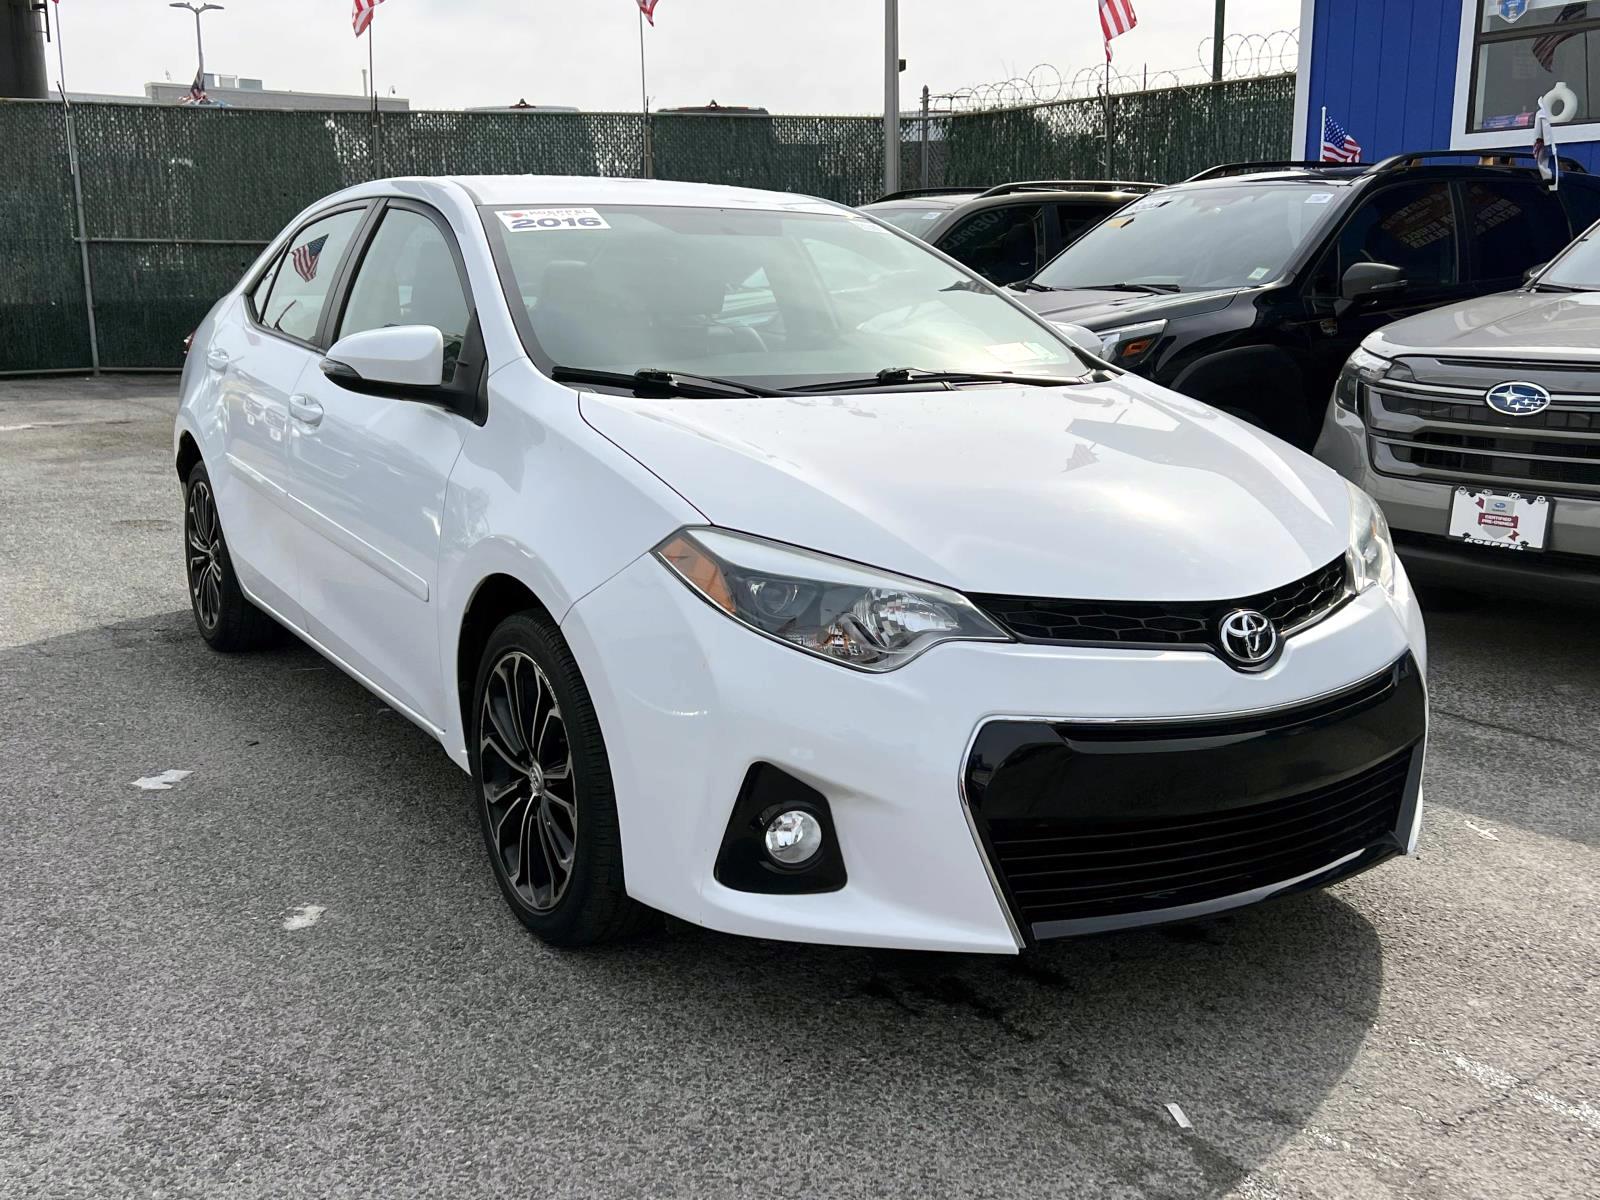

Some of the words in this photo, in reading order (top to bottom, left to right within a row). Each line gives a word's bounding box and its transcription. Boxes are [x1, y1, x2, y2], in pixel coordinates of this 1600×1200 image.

[511, 217, 602, 229] 2016
[1481, 518, 1514, 527] PRE-OWNED
[1484, 514, 1512, 522] CERTIFIED
[1464, 537, 1524, 551] KOEPPEL
